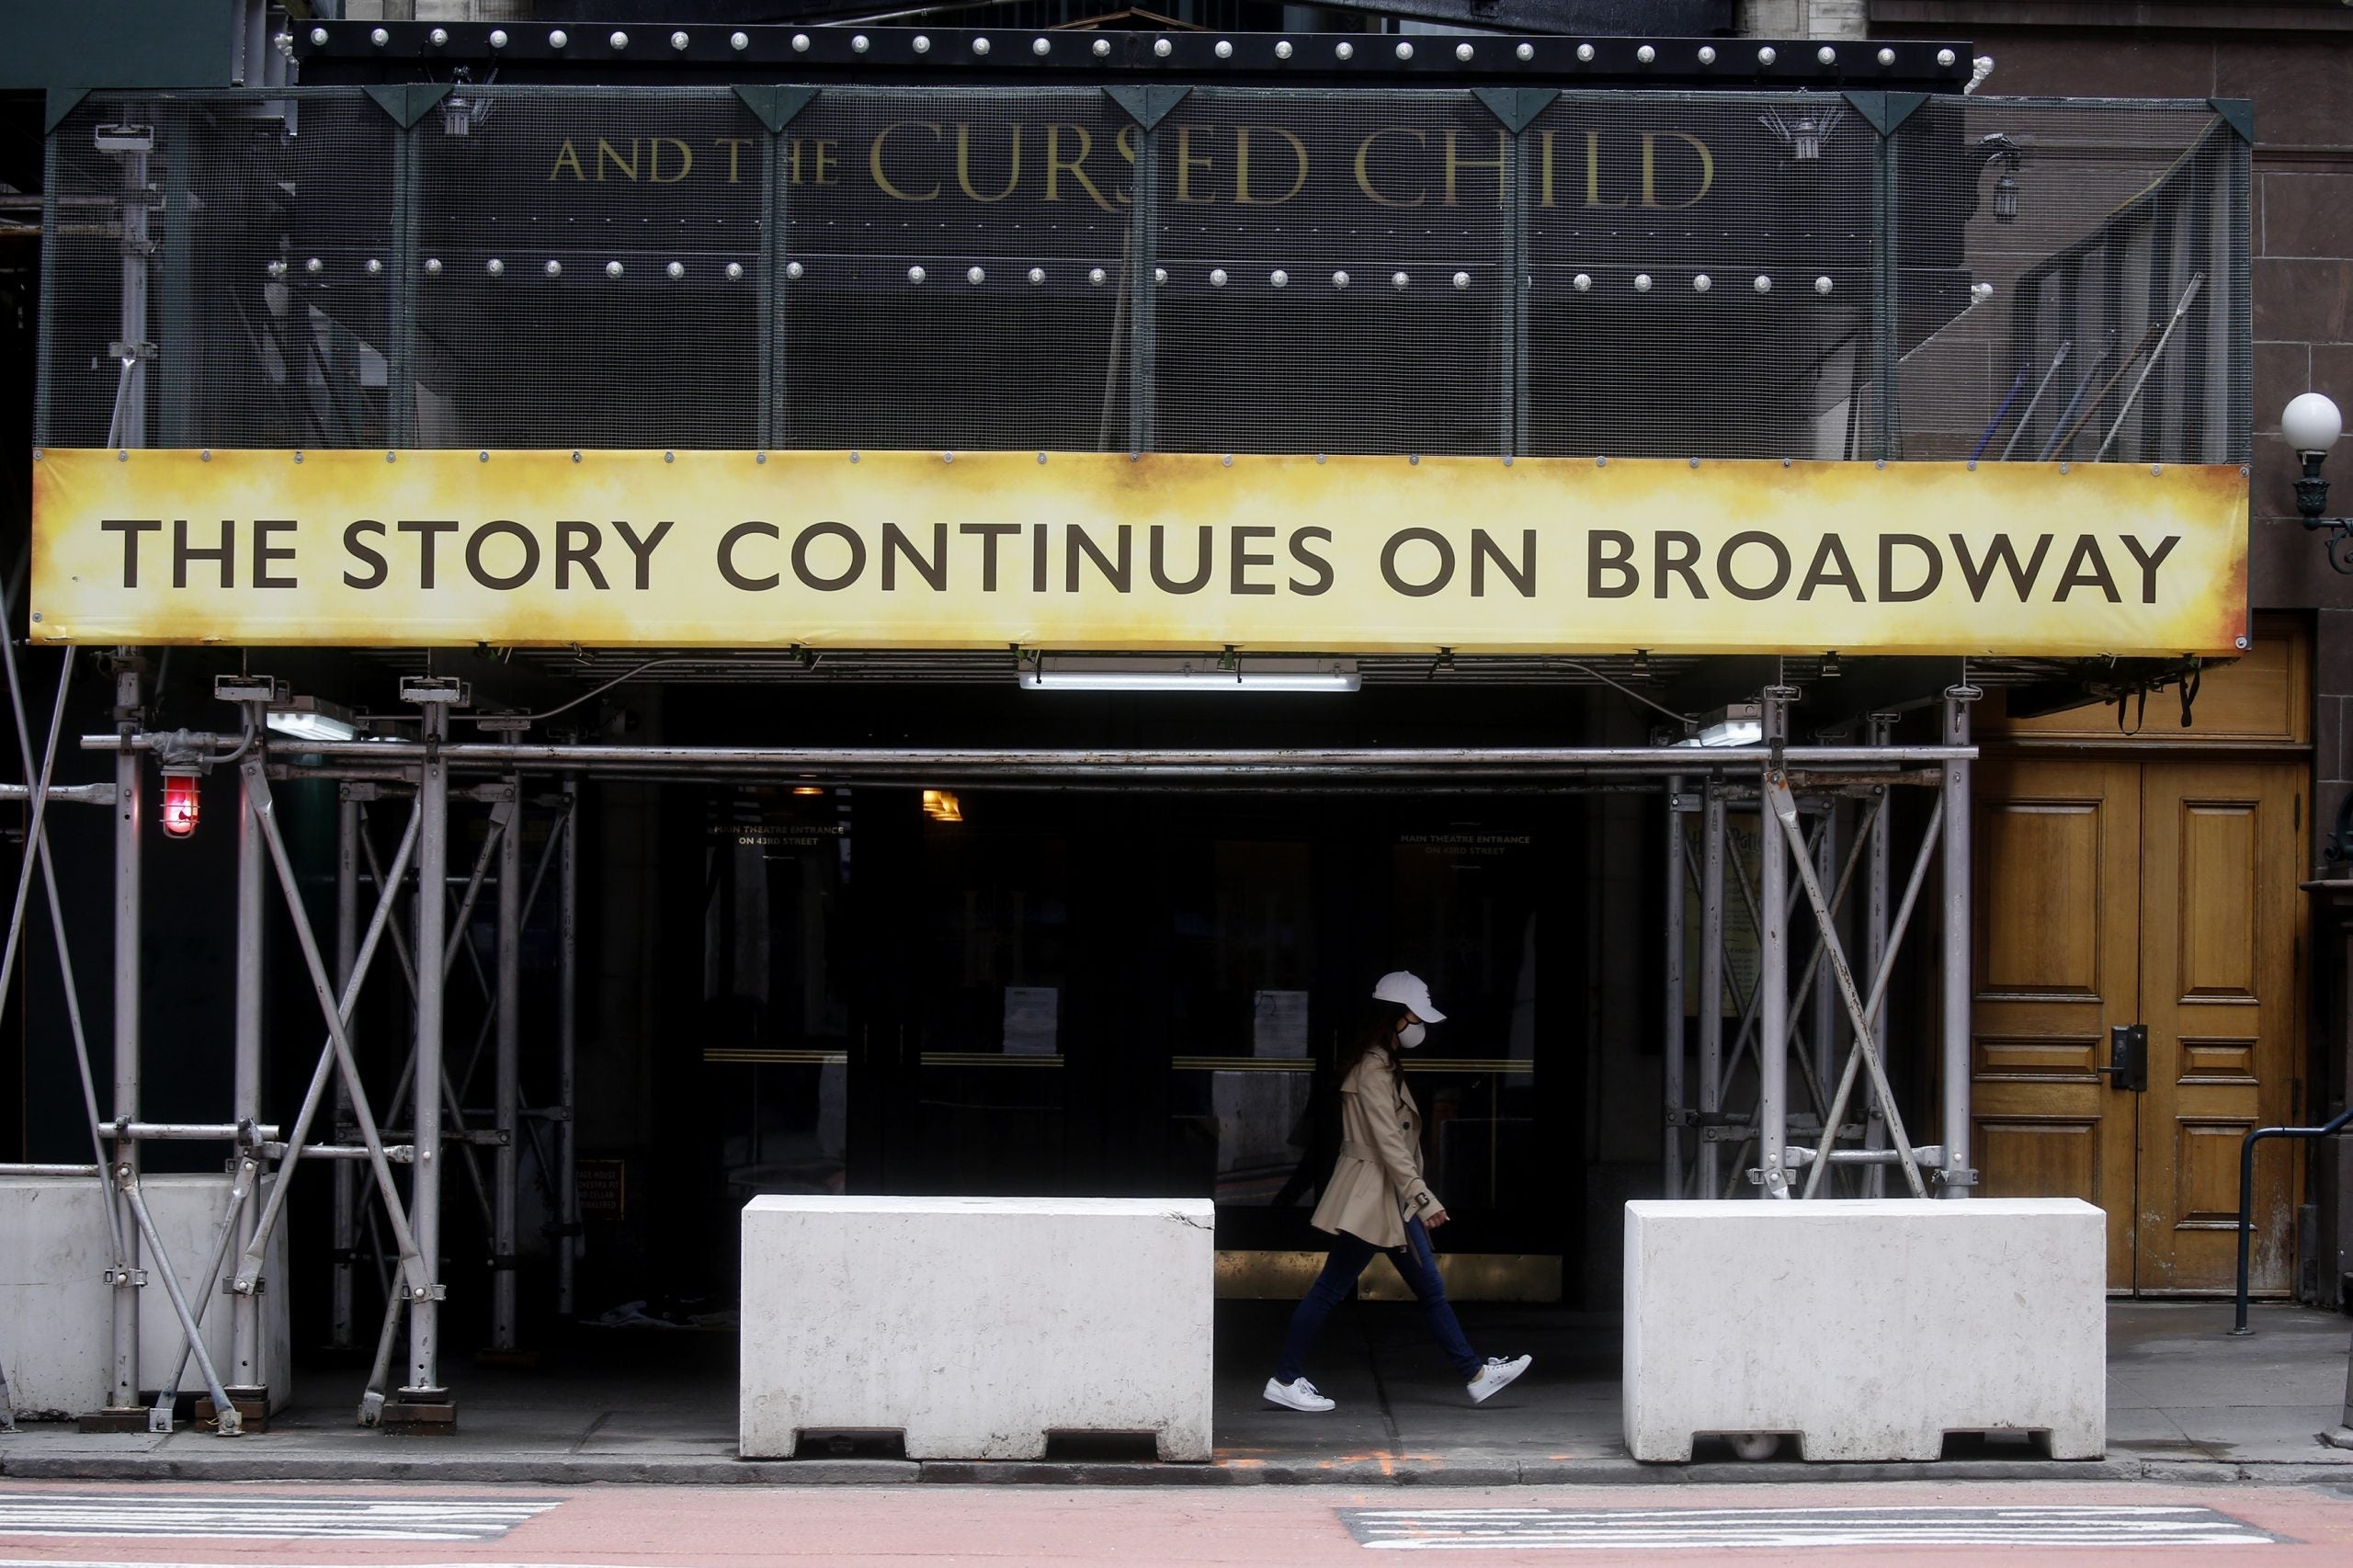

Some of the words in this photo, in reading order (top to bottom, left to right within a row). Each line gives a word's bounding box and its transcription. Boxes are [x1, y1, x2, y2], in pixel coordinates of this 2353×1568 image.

[550, 137, 693, 183] AND
[870, 122, 1309, 211] CURSED
[1354, 126, 1714, 210] CHILD
[101, 520, 297, 588] THE
[344, 520, 674, 590] STORY
[717, 522, 1334, 596] CONTINUES
[1381, 528, 1536, 597] ON
[1588, 530, 2181, 603] BROADWAY
[714, 825, 741, 834] MAIN
[790, 826, 844, 835] ENTRANCE
[756, 837, 780, 846] 43RD
[1401, 835, 1427, 843] MAIN
[1476, 835, 1530, 844] ENTRANCE
[1470, 846, 1505, 855] STREET
